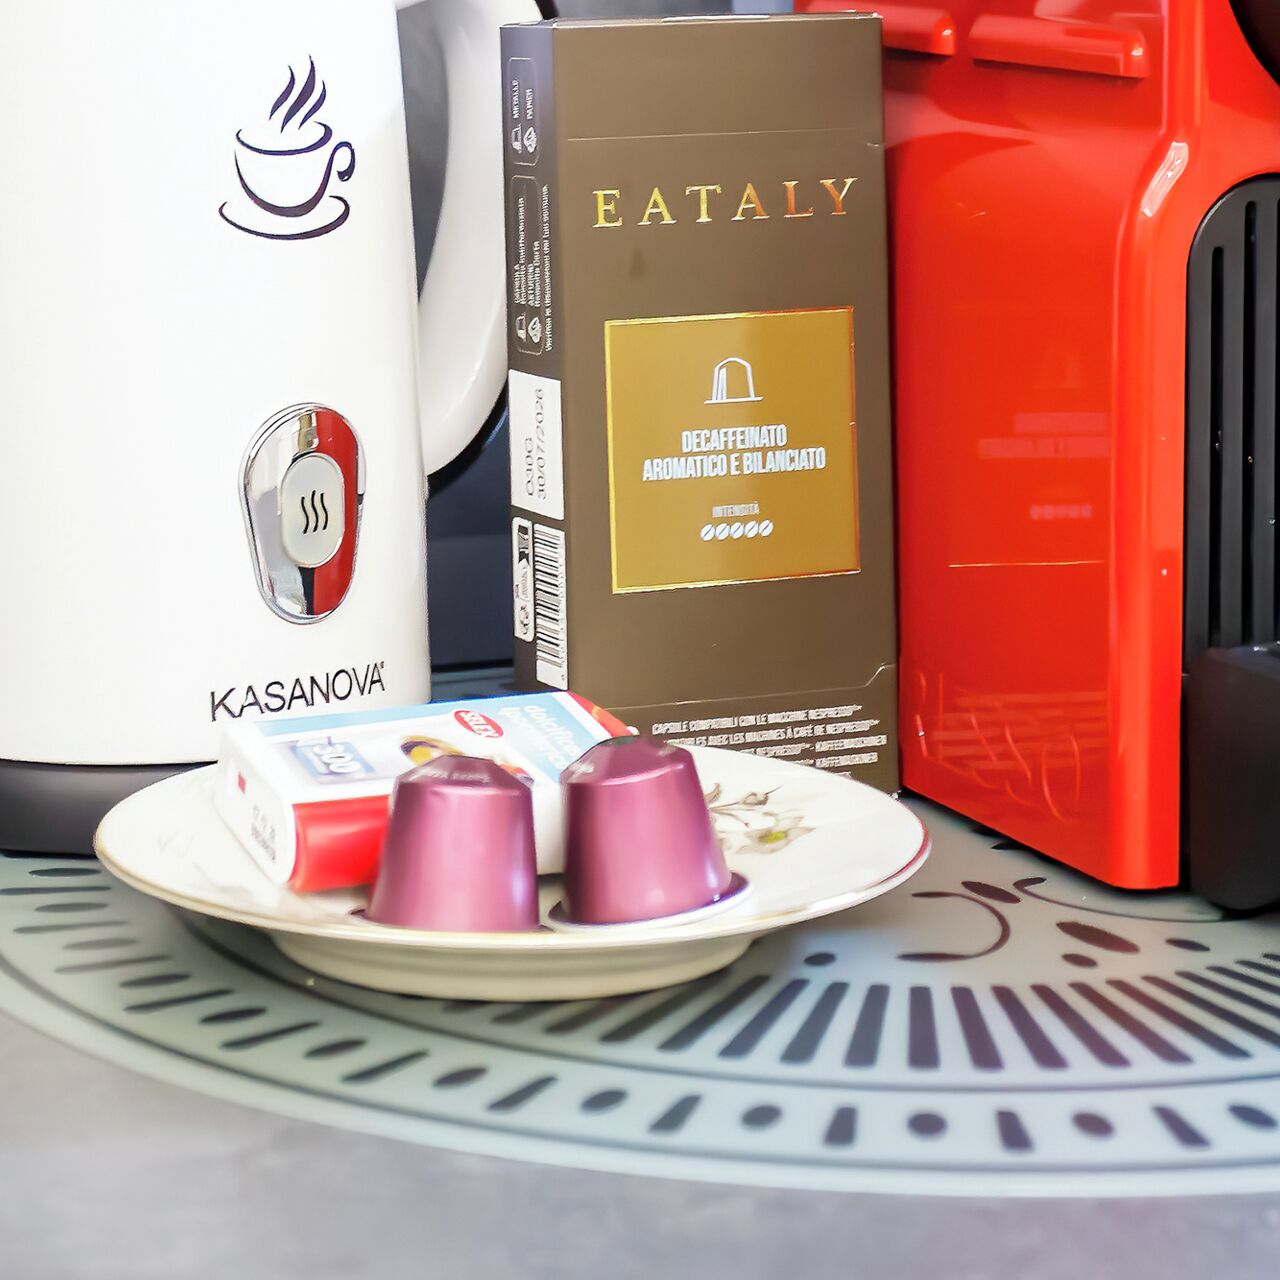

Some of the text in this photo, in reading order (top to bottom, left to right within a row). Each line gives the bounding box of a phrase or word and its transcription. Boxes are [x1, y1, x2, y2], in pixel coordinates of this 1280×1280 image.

[592, 177, 859, 228] EATALY
[681, 424, 787, 453] DECAFFEINATO
[642, 447, 826, 481] AROMATICO E BILANCIATO
[460, 710, 499, 738] SELEX
[756, 713, 767, 725] LE
[729, 732, 745, 744] LES
